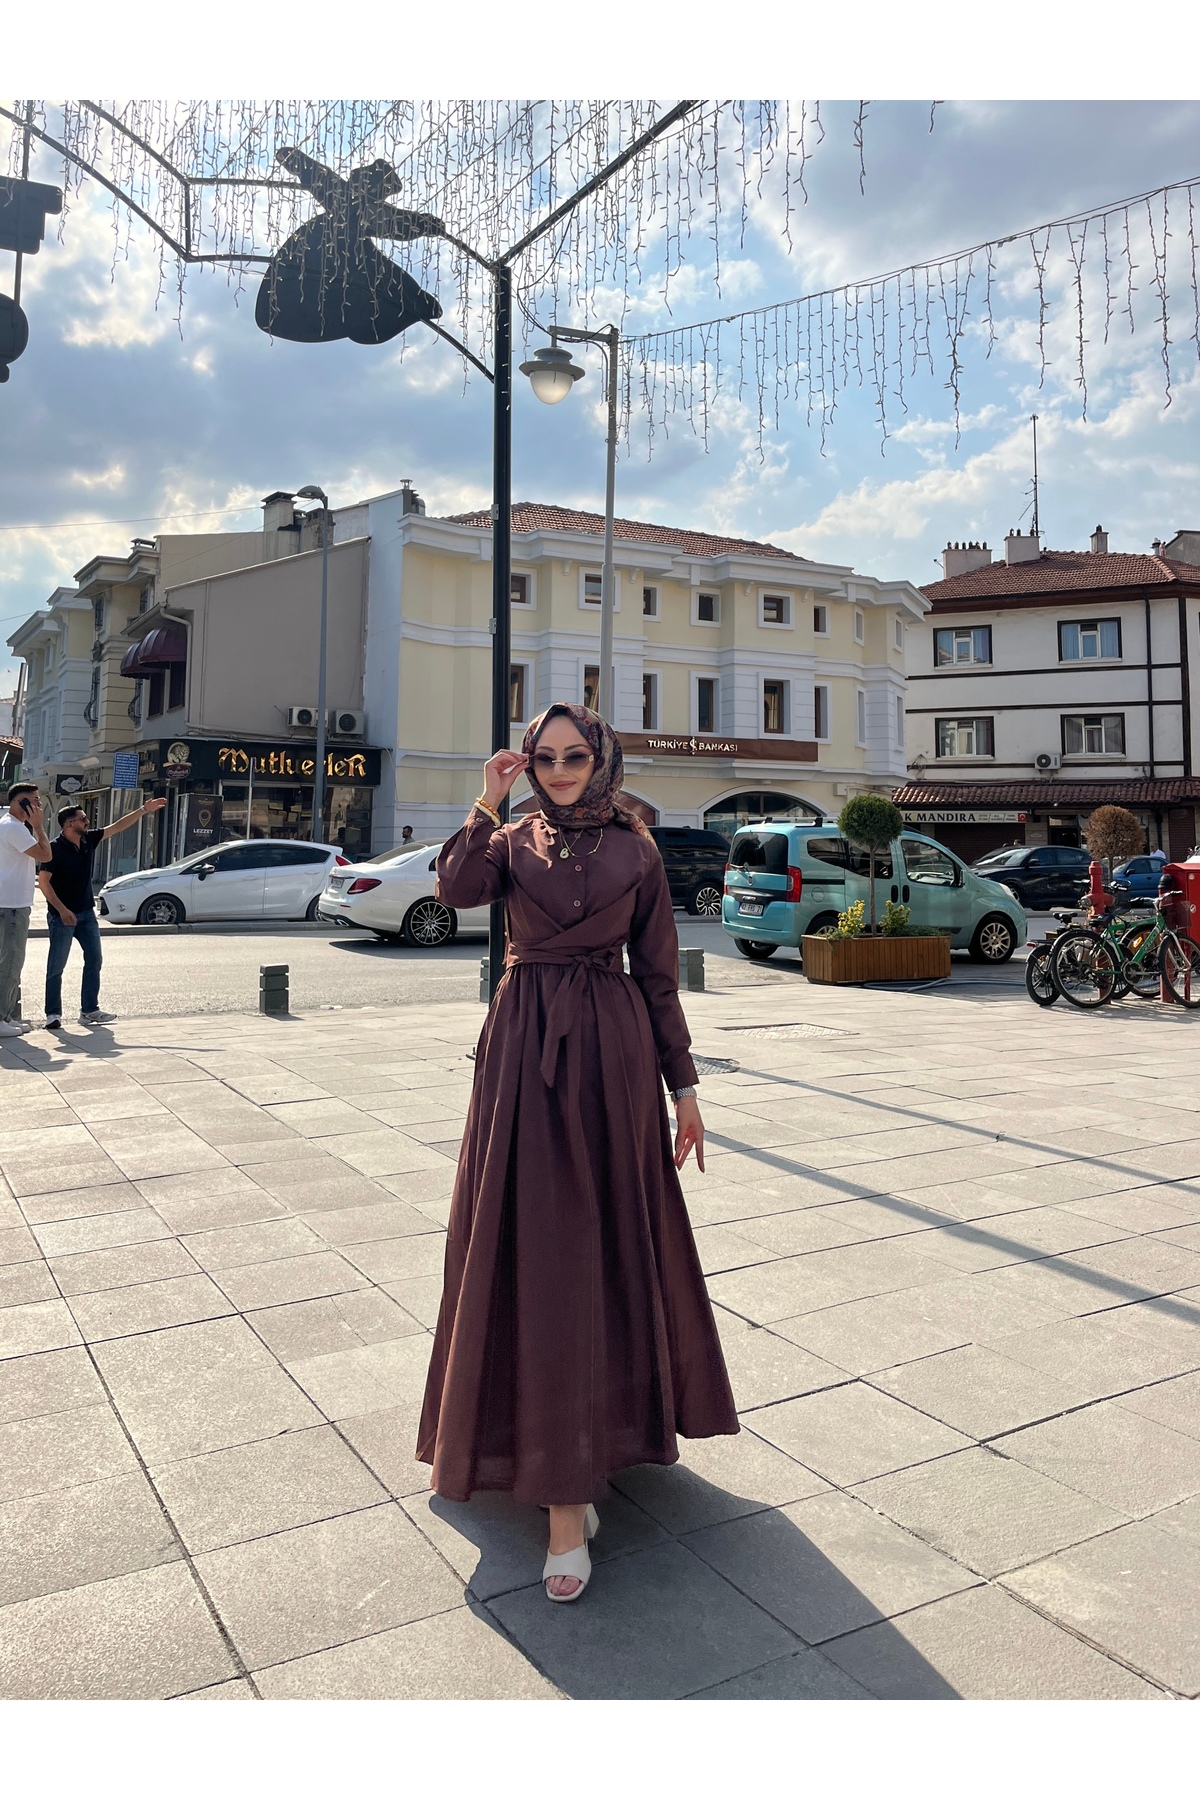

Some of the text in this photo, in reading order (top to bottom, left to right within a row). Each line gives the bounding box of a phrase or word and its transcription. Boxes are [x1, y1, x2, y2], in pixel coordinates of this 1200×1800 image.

[647, 738, 738, 752] TÜRKİYE BANKASI
[916, 813, 976, 821] MANDIRA
